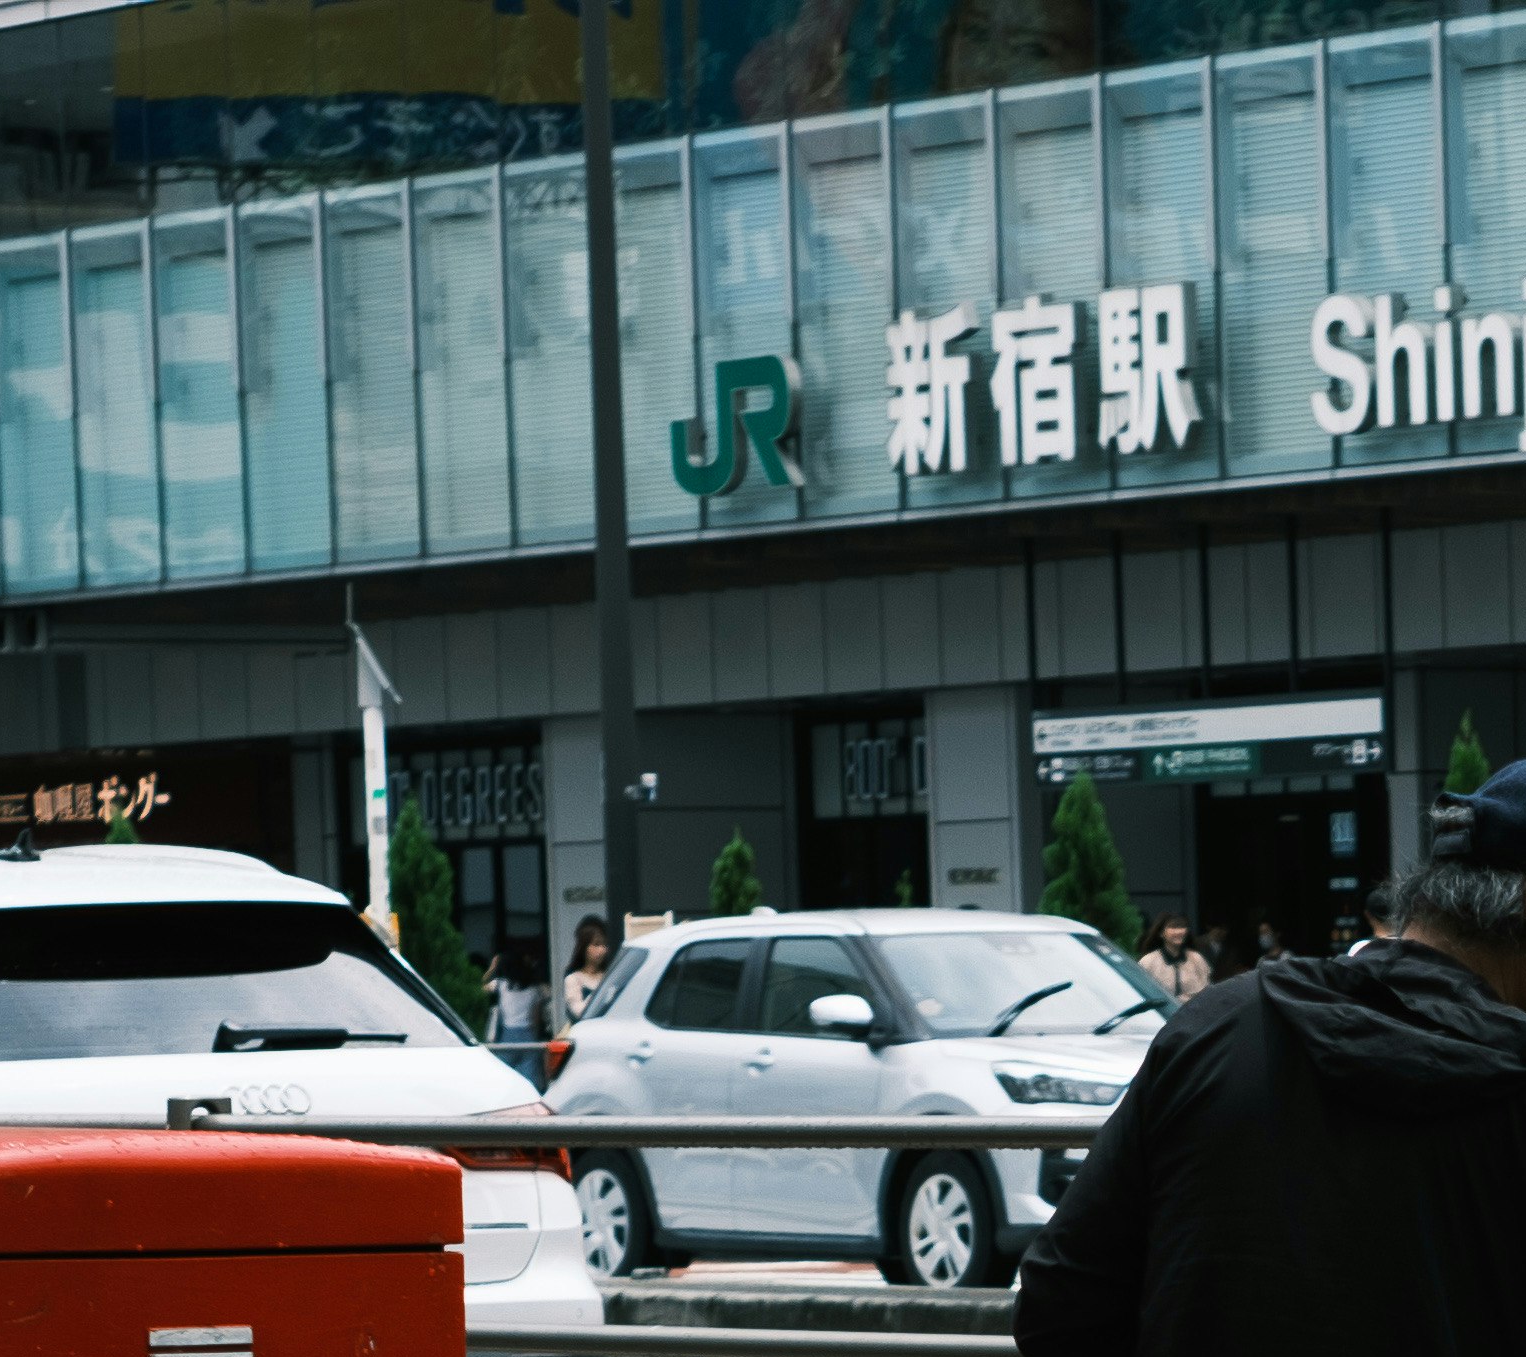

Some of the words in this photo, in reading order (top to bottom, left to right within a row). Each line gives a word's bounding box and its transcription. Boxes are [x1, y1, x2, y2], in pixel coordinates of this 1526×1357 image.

[670, 354, 805, 497] JR
[886, 281, 1201, 477] 新宿駅
